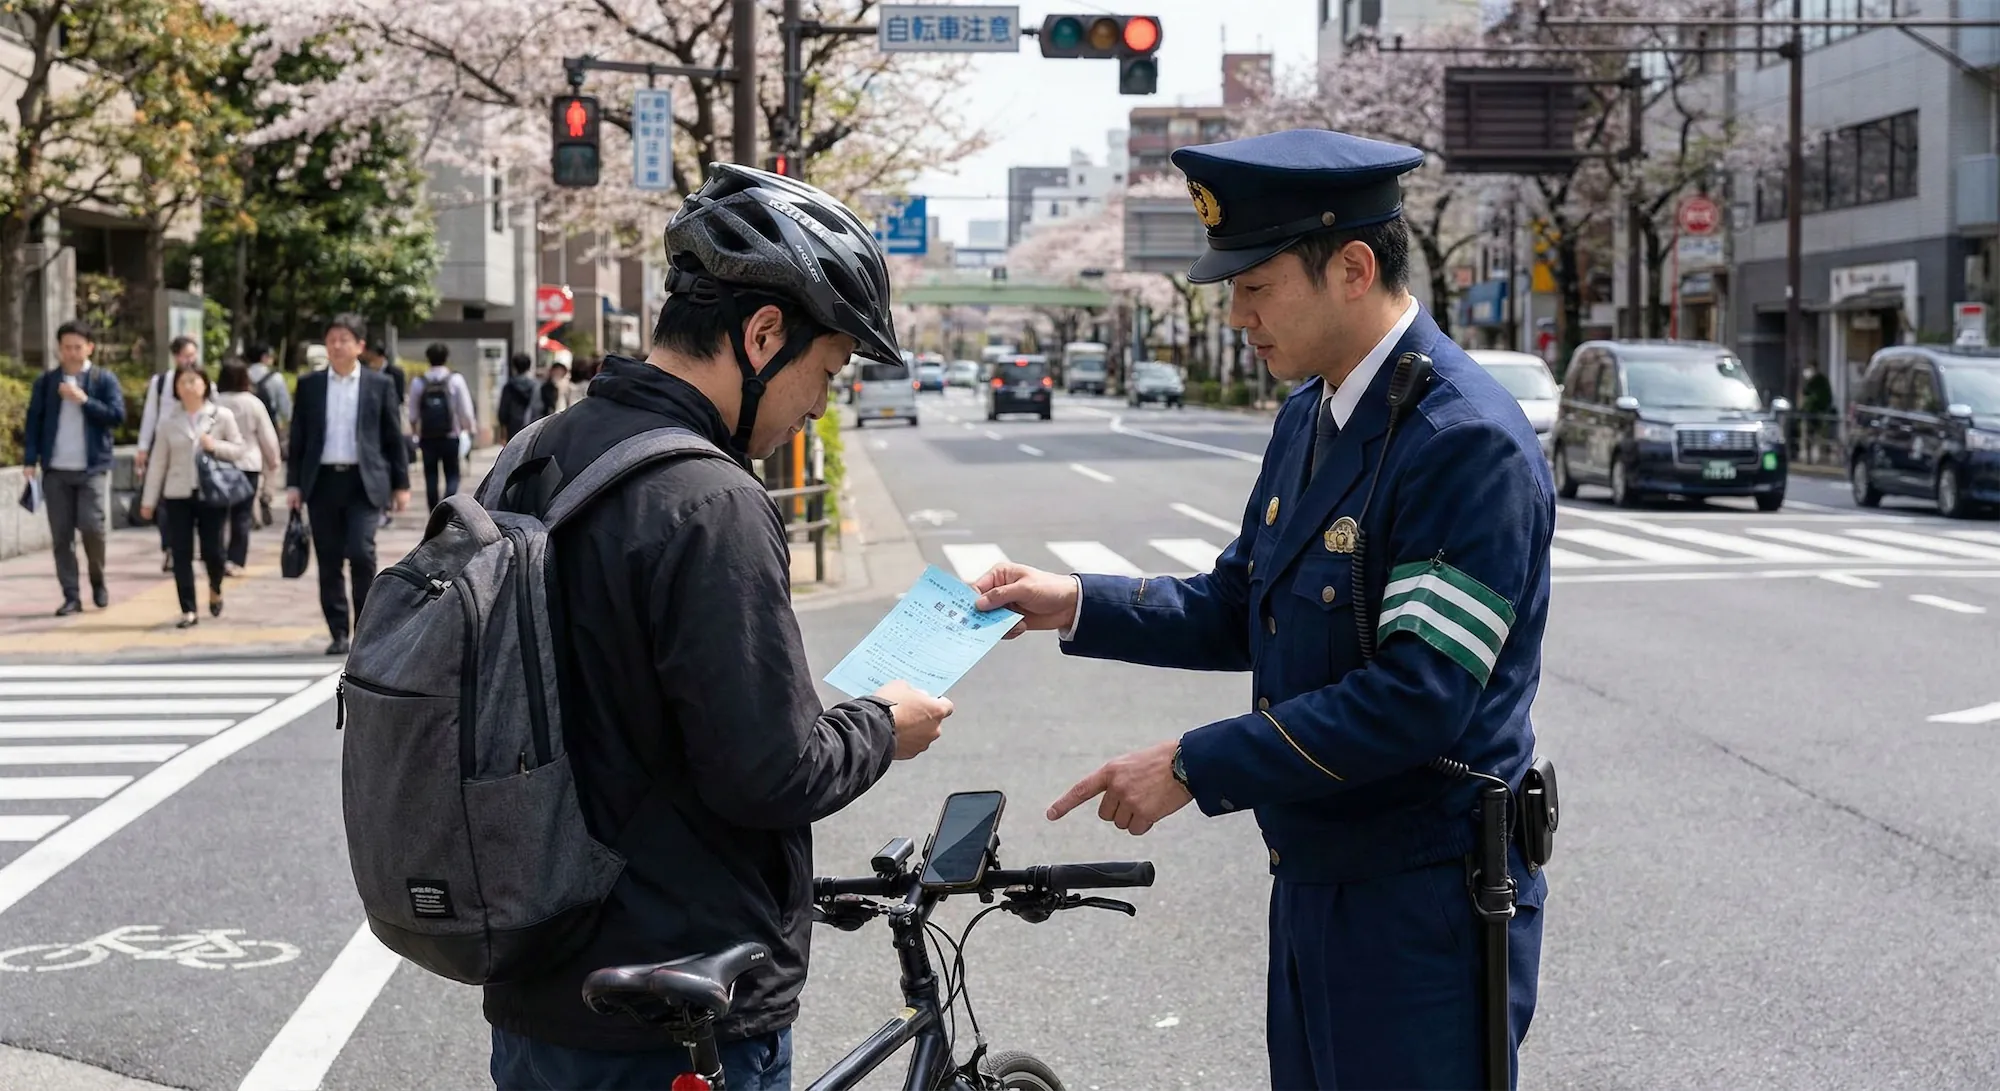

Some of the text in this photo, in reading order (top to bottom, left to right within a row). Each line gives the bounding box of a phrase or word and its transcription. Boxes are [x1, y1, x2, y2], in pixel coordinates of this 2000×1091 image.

[887, 15, 1011, 43] 自転車注意
